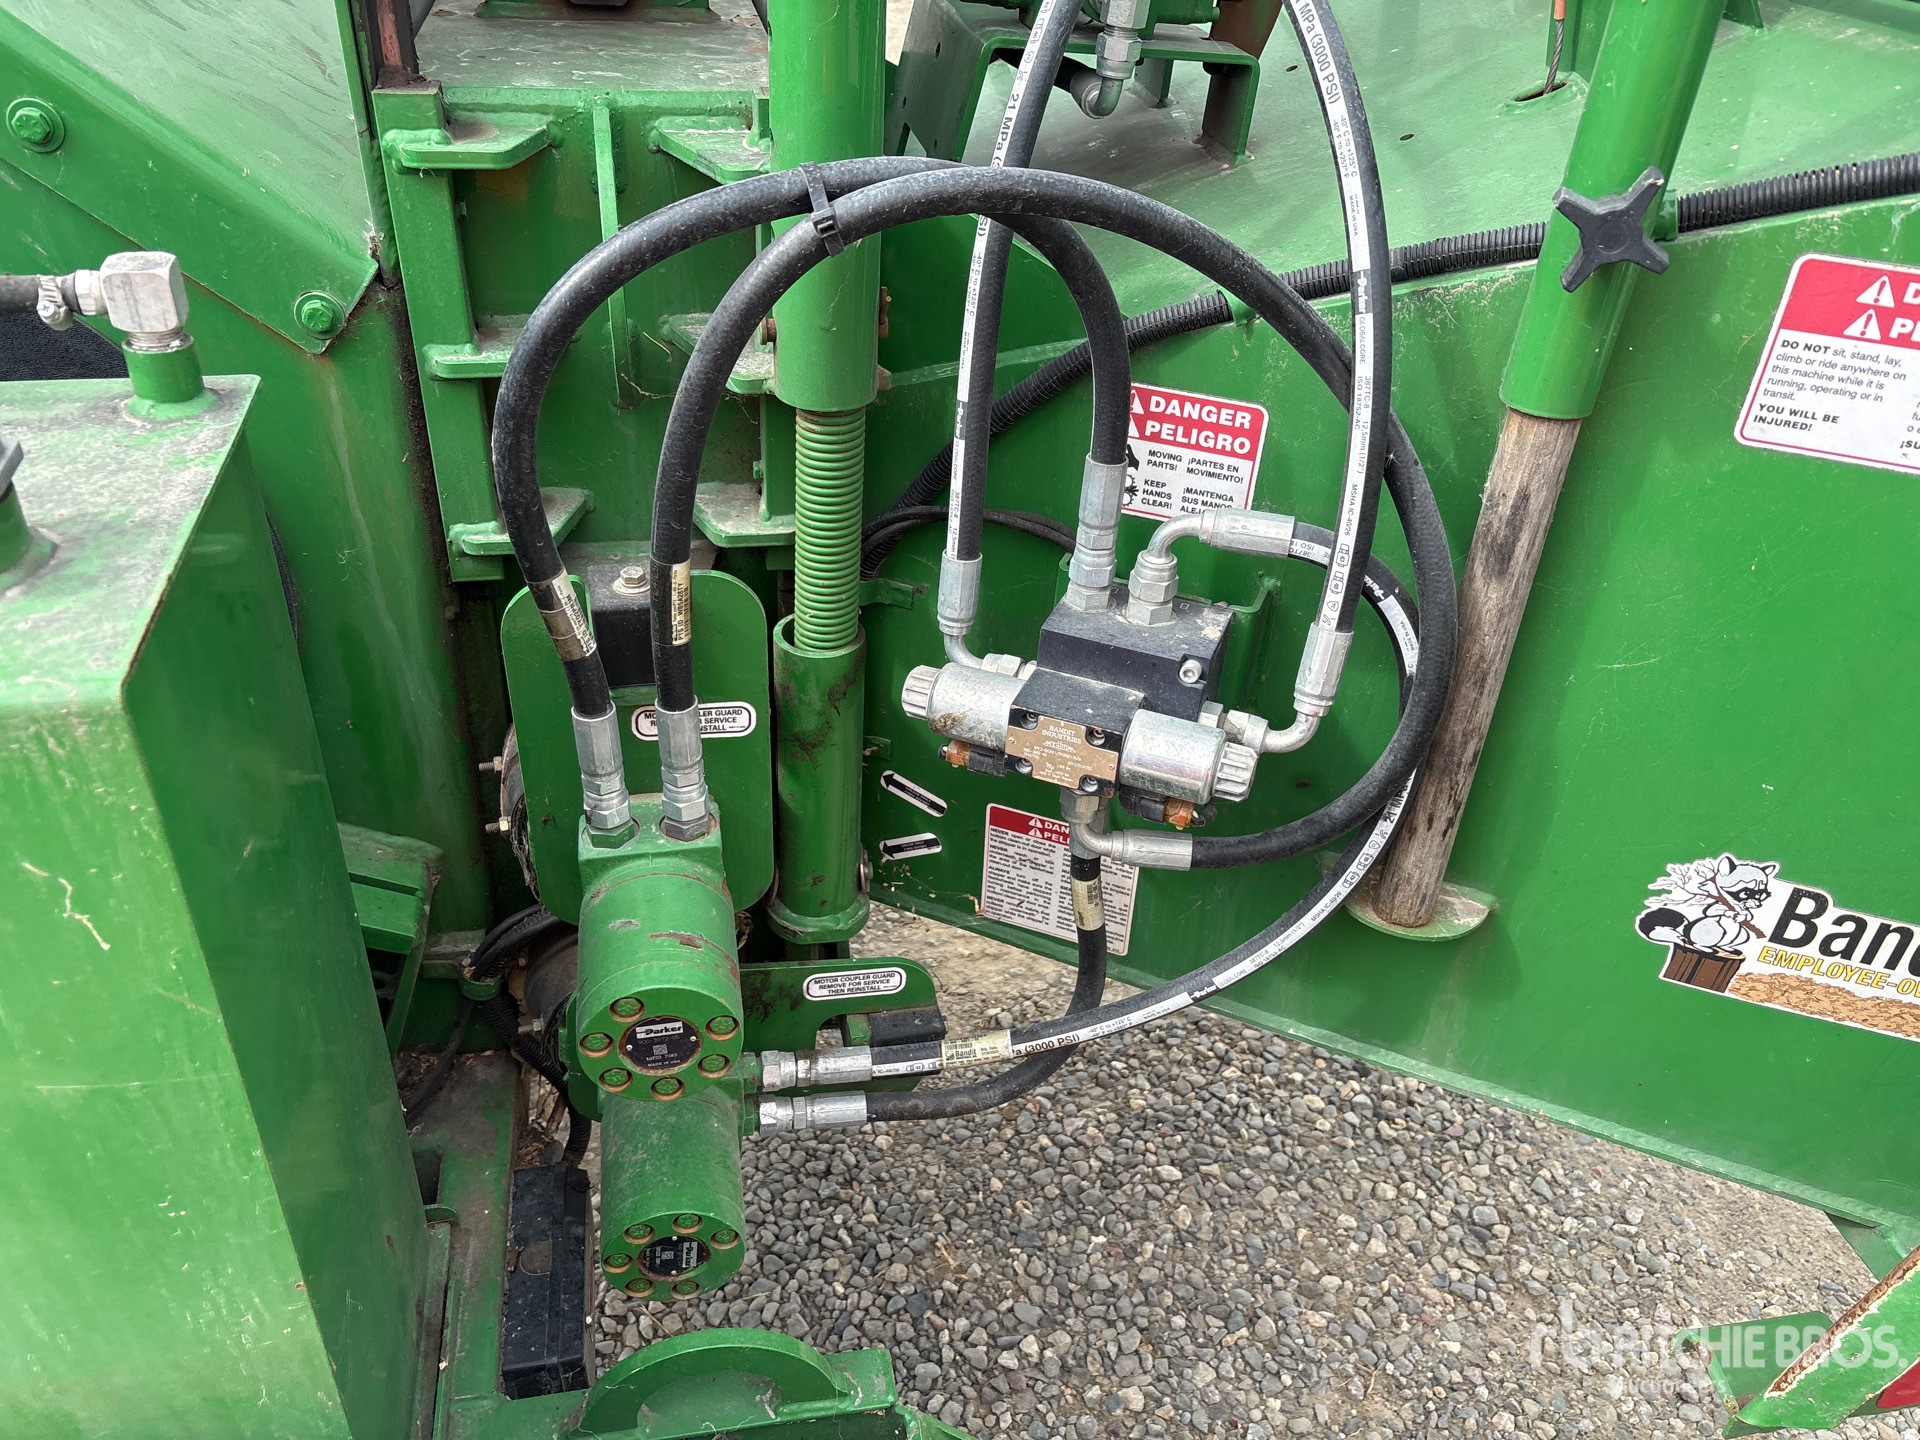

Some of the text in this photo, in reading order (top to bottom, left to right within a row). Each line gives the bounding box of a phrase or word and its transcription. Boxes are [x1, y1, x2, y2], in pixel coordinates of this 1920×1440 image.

[1310, 34, 1331, 72] (3000
[1323, 72, 1340, 104] PSI)
[1008, 94, 1019, 110] 21
[997, 117, 1012, 150] MPa
[977, 215, 988, 237] SI)
[1357, 278, 1368, 313] Parker
[1781, 339, 1901, 367] DO NOT sit, stand, lay,
[1776, 353, 1906, 381] climb or ride anywhere on
[1771, 364, 1885, 390] this machine while it is
[1763, 388, 1795, 401] transit.
[1767, 377, 1883, 402] running, operating or in
[1149, 396, 1252, 429] DANGER
[1758, 403, 1840, 424] YOU WILL BE
[1753, 415, 1813, 432] INJURED!
[1145, 420, 1250, 454] PELIGRO
[1148, 450, 1182, 462] MOVING
[1147, 460, 1177, 472] PARTS!
[1188, 458, 1239, 473] ¡PARTES EN
[1144, 479, 1167, 488] KEEP
[1186, 467, 1243, 484] MOVIMIENTO!
[1142, 488, 1172, 499] HANDS
[1181, 496, 1199, 505] SUS
[1183, 487, 1234, 503] ¡MANTENGA
[1350, 484, 1358, 506] MSHA
[1141, 498, 1172, 510] CLEAR!
[1180, 506, 1206, 514] ALEJ
[1049, 725, 1076, 737] BANDIT
[819, 982, 846, 990] REMOVE
[841, 974, 871, 982] COUPLER
[646, 1026, 682, 1035] Parker
[1024, 1034, 1080, 1054] (3000 PSI)
